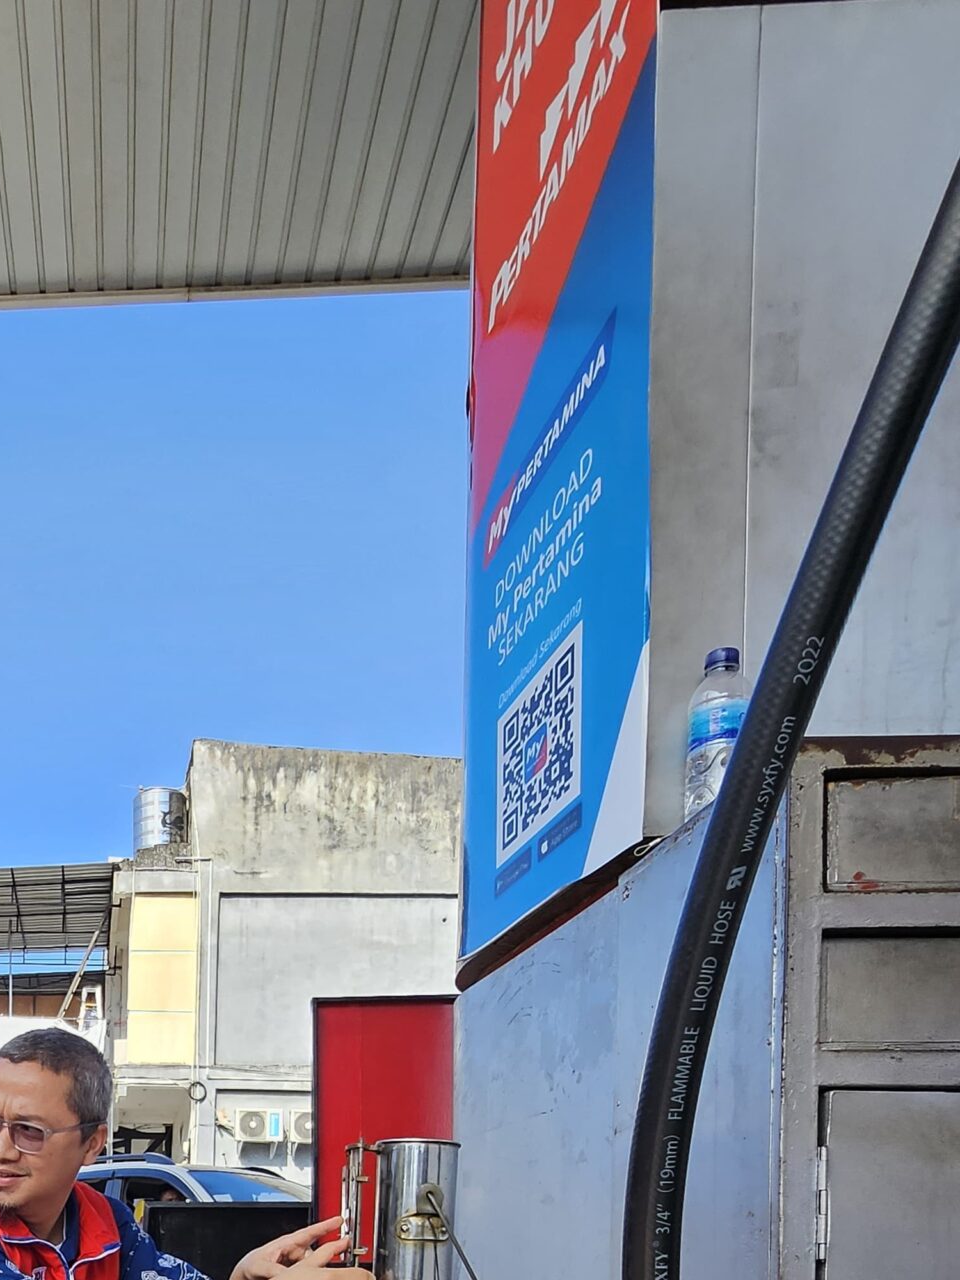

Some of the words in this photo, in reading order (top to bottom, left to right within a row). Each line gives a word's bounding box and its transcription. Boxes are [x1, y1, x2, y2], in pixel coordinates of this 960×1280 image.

[488, 0, 631, 335] PERTAMAX
[488, 604, 510, 650] My
[513, 476, 602, 613] Pertamina
[495, 447, 593, 609] DOWNLOAD
[498, 532, 585, 667] SEKARANG
[498, 648, 540, 709] Download
[539, 598, 583, 660] Sekarang
[740, 715, 797, 853] www.syxfy.com
[689, 956, 718, 1012] LIQUID
[708, 900, 737, 945] HOSE
[667, 1026, 700, 1121] FLAMMABLE
[656, 1134, 681, 1193] (19mm)
